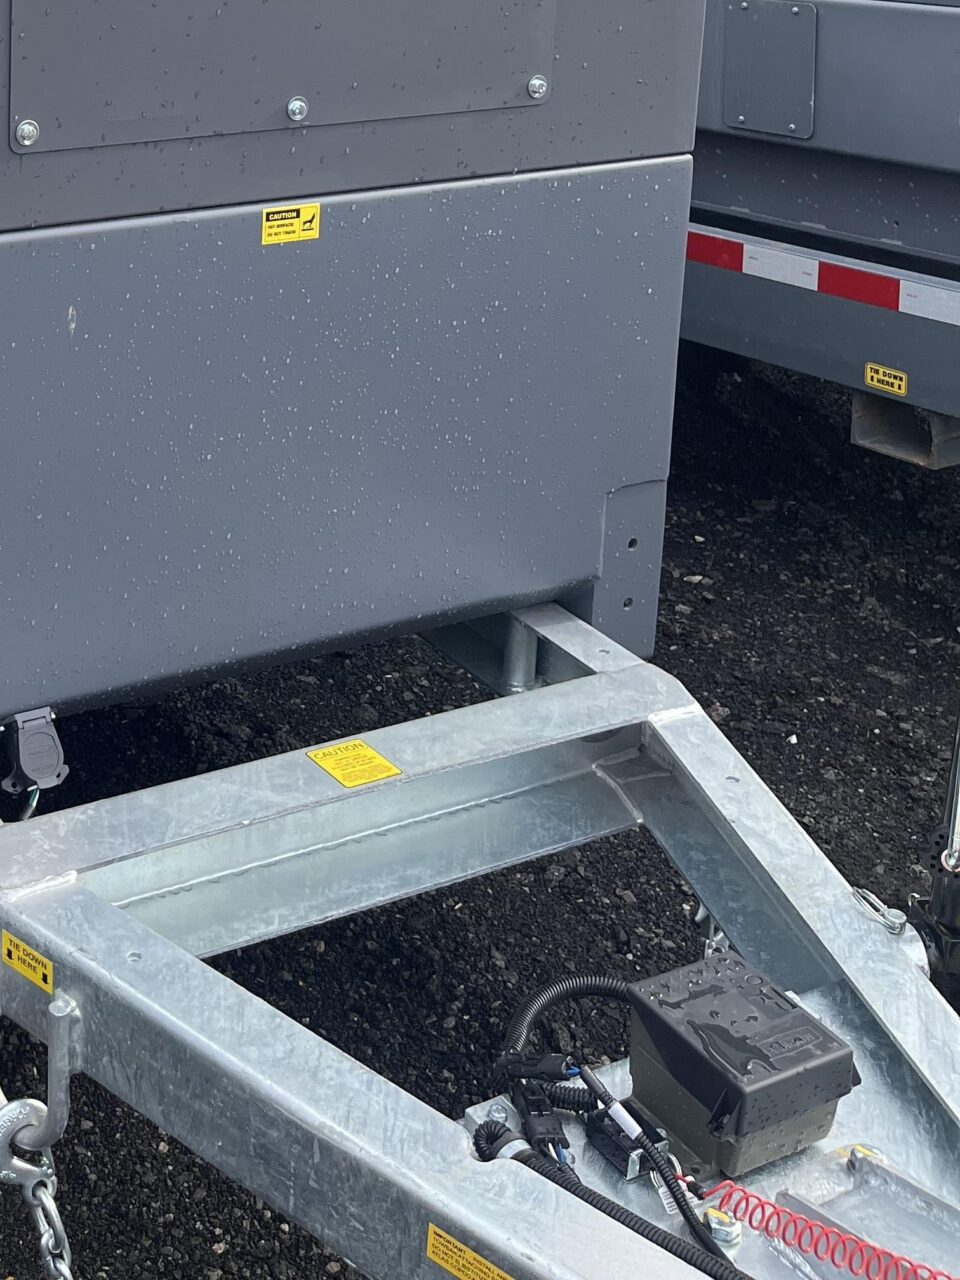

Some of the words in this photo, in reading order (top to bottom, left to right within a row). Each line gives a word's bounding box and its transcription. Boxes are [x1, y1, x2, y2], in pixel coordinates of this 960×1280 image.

[268, 211, 297, 221] CAUTION
[869, 366, 880, 376] TIE
[882, 370, 903, 382] DOWN
[876, 377, 895, 389] HERE
[313, 742, 365, 760] CAUTION
[8, 937, 21, 953] TIE
[22, 948, 47, 970] DOWN
[17, 954, 39, 974] HERE
[433, 1230, 466, 1255] IMPORTANT
